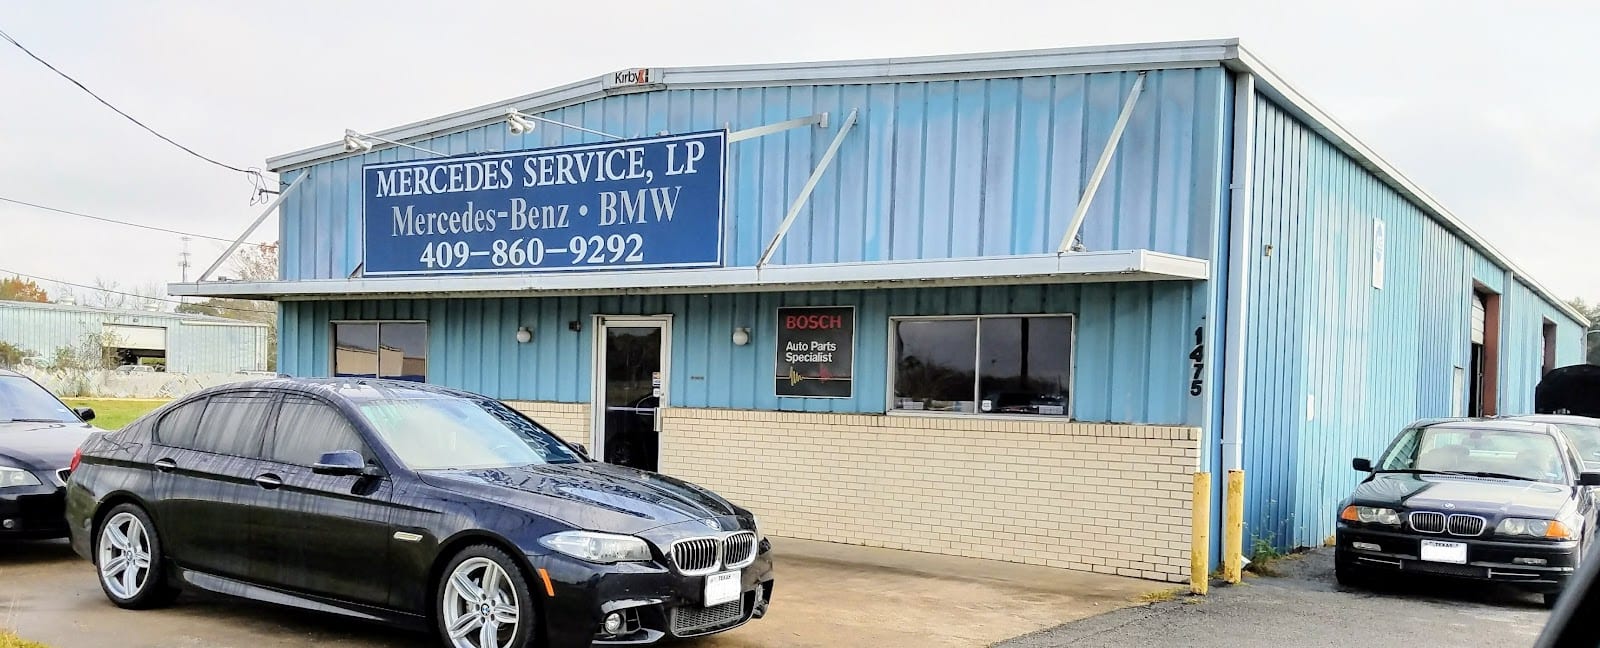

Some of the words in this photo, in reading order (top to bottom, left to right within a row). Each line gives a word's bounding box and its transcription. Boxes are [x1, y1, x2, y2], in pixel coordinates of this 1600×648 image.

[615, 71, 640, 84] Kirby
[376, 160, 513, 197] MERCEDES
[523, 148, 654, 188] SERVICE,
[666, 140, 706, 175] LP
[391, 198, 570, 237] Mercedes-Benz
[598, 186, 682, 227] BMW
[419, 233, 644, 268] 409-860-9292
[786, 315, 842, 329] BOSCH
[785, 341, 809, 351] Auto
[811, 341, 837, 351] Parts
[785, 352, 832, 364] Specialist
[1189, 326, 1204, 396] 1475
